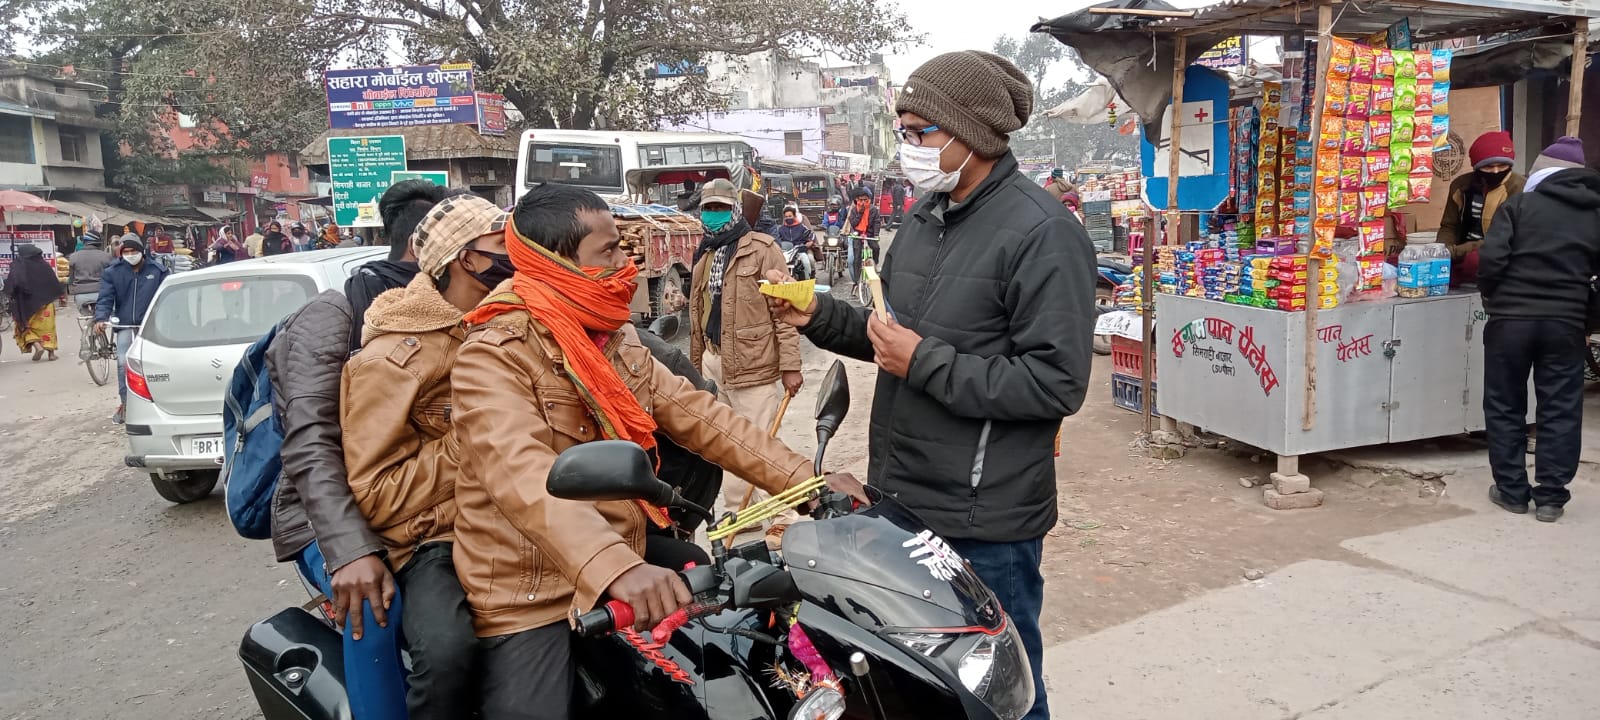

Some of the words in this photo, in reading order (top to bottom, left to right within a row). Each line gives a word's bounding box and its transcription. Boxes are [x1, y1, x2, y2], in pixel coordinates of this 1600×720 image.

[327, 75, 368, 89] सहारा
[1316, 325, 1343, 344] पान
[1204, 317, 1236, 345] पान
[1238, 325, 1279, 397] पैलेस
[1336, 334, 1374, 363] पैलेस
